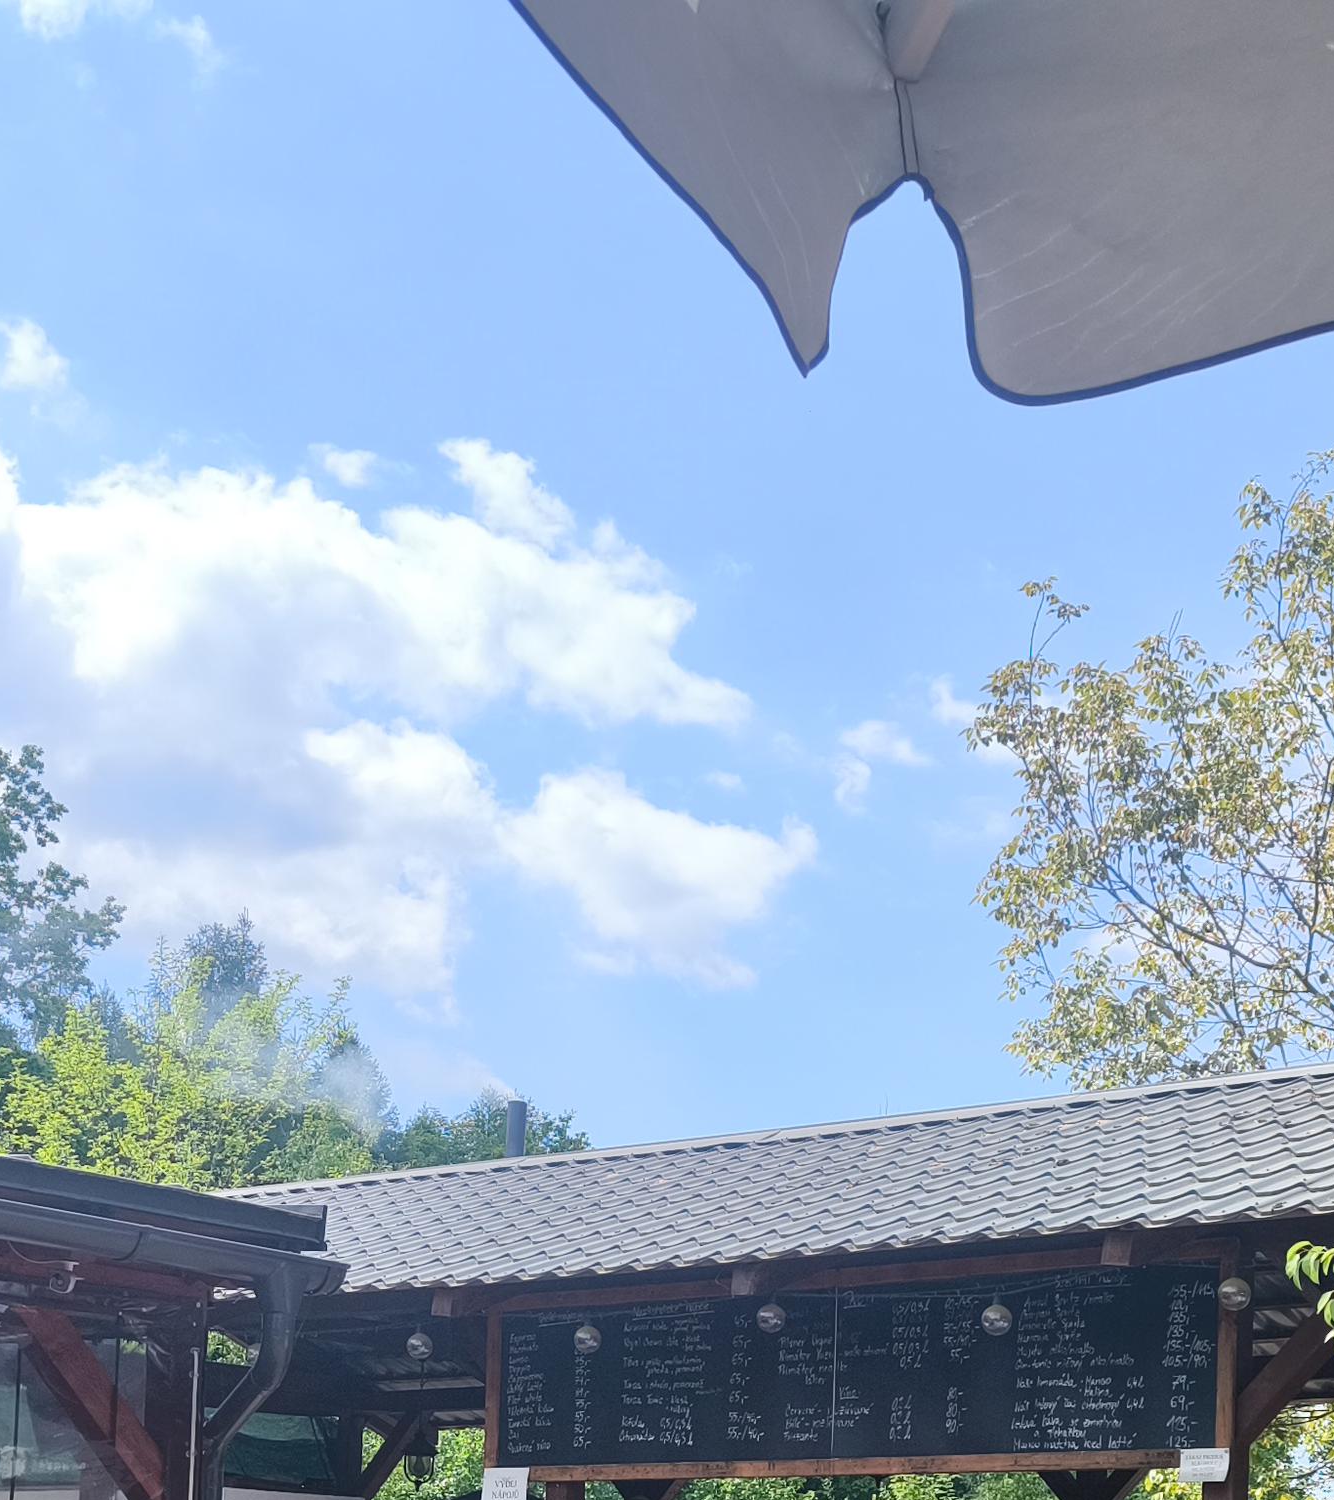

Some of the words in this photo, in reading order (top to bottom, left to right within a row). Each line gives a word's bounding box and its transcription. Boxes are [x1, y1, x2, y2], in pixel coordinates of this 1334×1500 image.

[1171, 1375, 1196, 1391] 79,-
[1170, 1395, 1195, 1412] 69,-
[573, 1436, 592, 1449] 65,-
[494, 1478, 517, 1488] VÝDEJ
